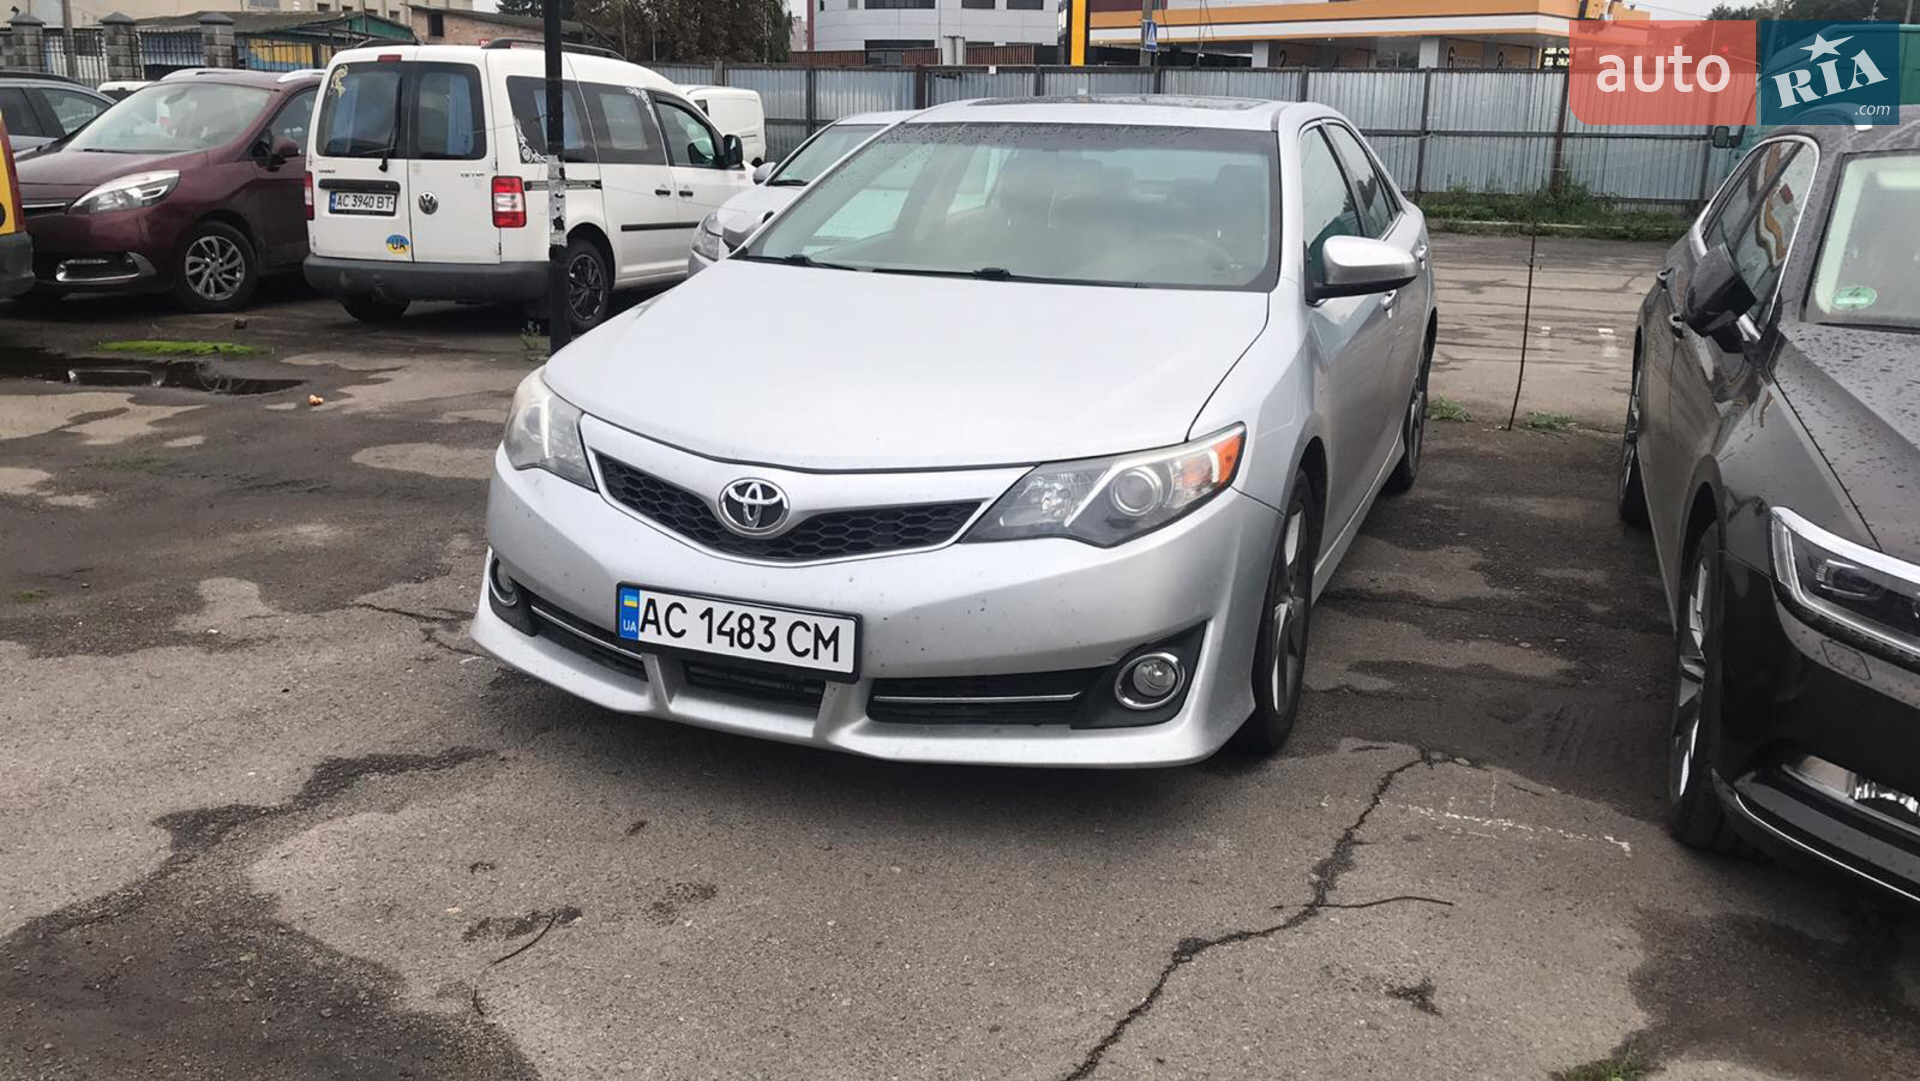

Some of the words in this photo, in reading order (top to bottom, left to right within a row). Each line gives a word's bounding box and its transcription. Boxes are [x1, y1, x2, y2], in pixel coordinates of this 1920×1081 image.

[336, 194, 350, 208] AC
[351, 194, 376, 209] 3940
[391, 239, 406, 250] UA
[623, 620, 637, 633] UA
[639, 598, 688, 639] AC
[699, 606, 777, 653] 1483
[786, 620, 840, 663] CM
